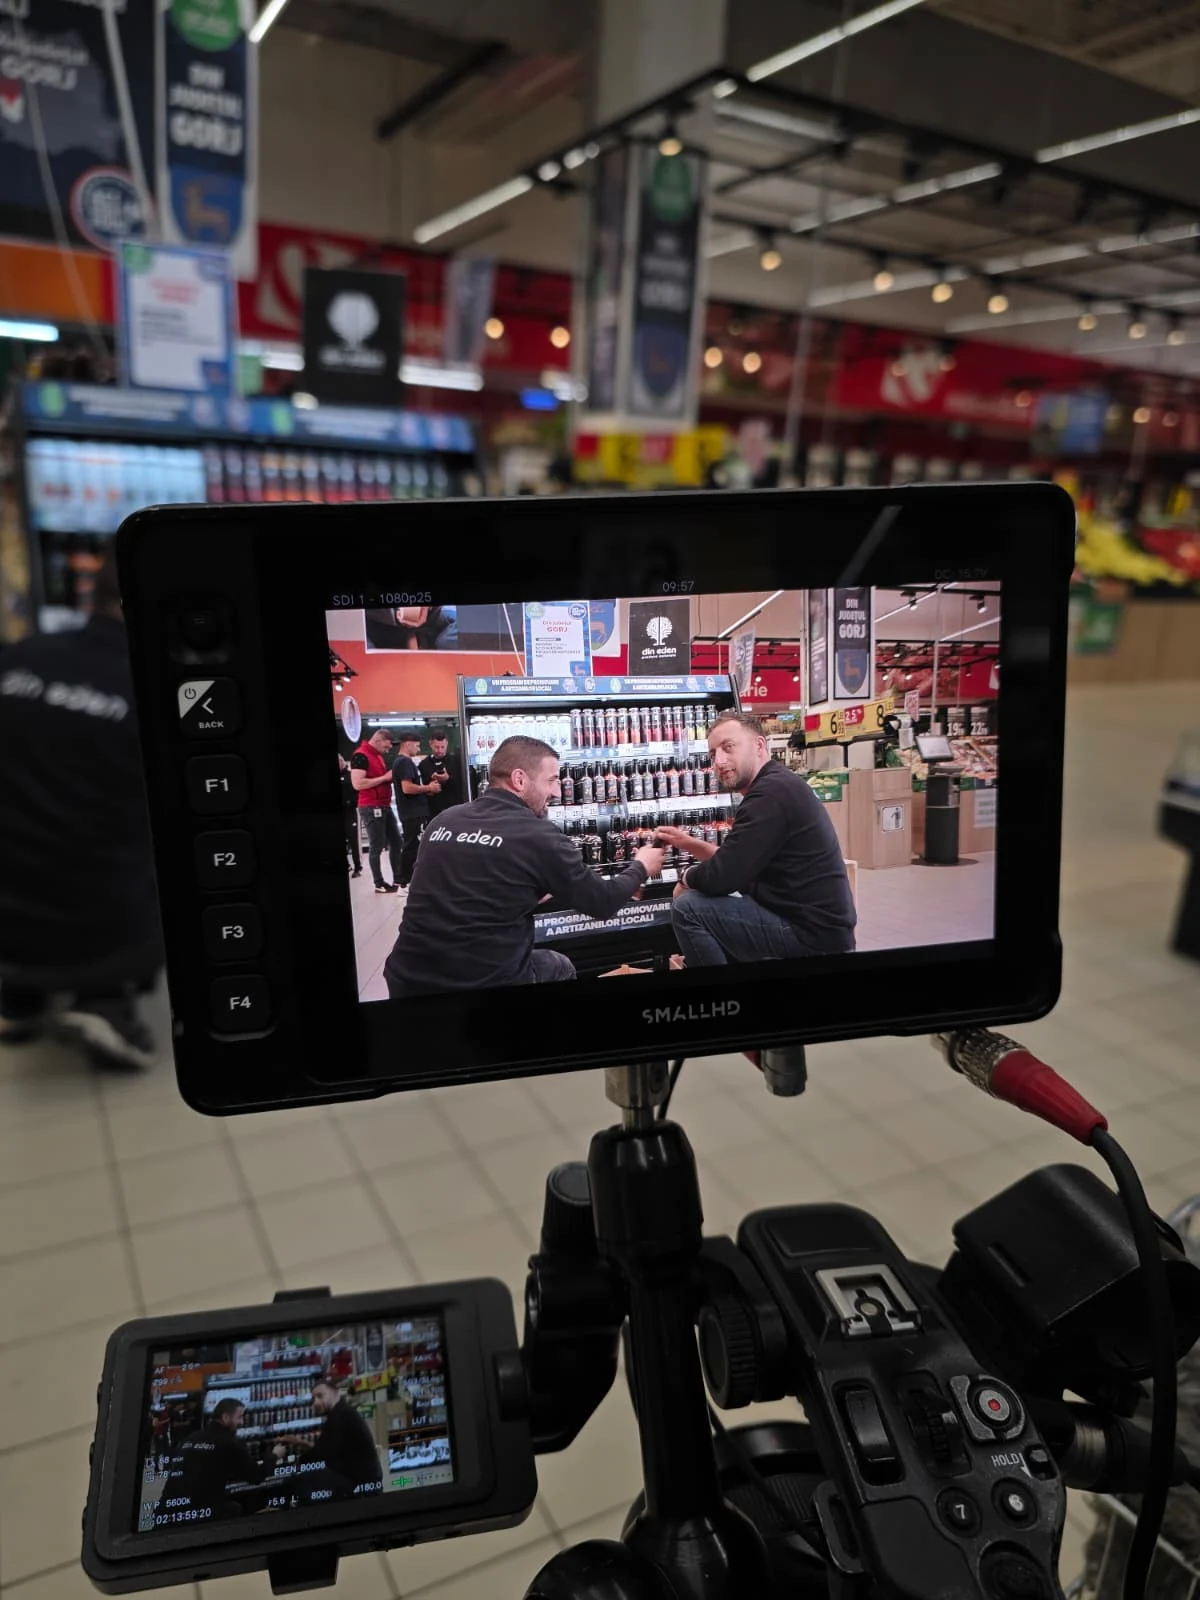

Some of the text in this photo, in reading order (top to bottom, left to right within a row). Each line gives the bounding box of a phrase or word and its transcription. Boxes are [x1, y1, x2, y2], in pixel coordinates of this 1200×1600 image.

[662, 581, 695, 593] 09:57
[333, 595, 354, 606] SDI
[379, 592, 432, 606] 1080p25
[839, 623, 866, 639] GORJ
[641, 646, 677, 656] din eden
[876, 704, 884, 727] 8
[198, 720, 224, 729] BACK
[830, 713, 838, 735] 6
[205, 778, 229, 793] F1
[429, 826, 452, 841] din
[456, 828, 503, 848] eden
[213, 852, 237, 867] F2
[534, 902, 671, 929] N PROGRA ROMOVARE
[221, 925, 245, 940] F3
[545, 913, 655, 937] A ARTIZANILOR LOCALI
[230, 995, 252, 1010] F4
[641, 1000, 741, 1024] SMALLHD
[990, 1452, 1020, 1468] HOLD
[955, 1504, 966, 1520] 7
